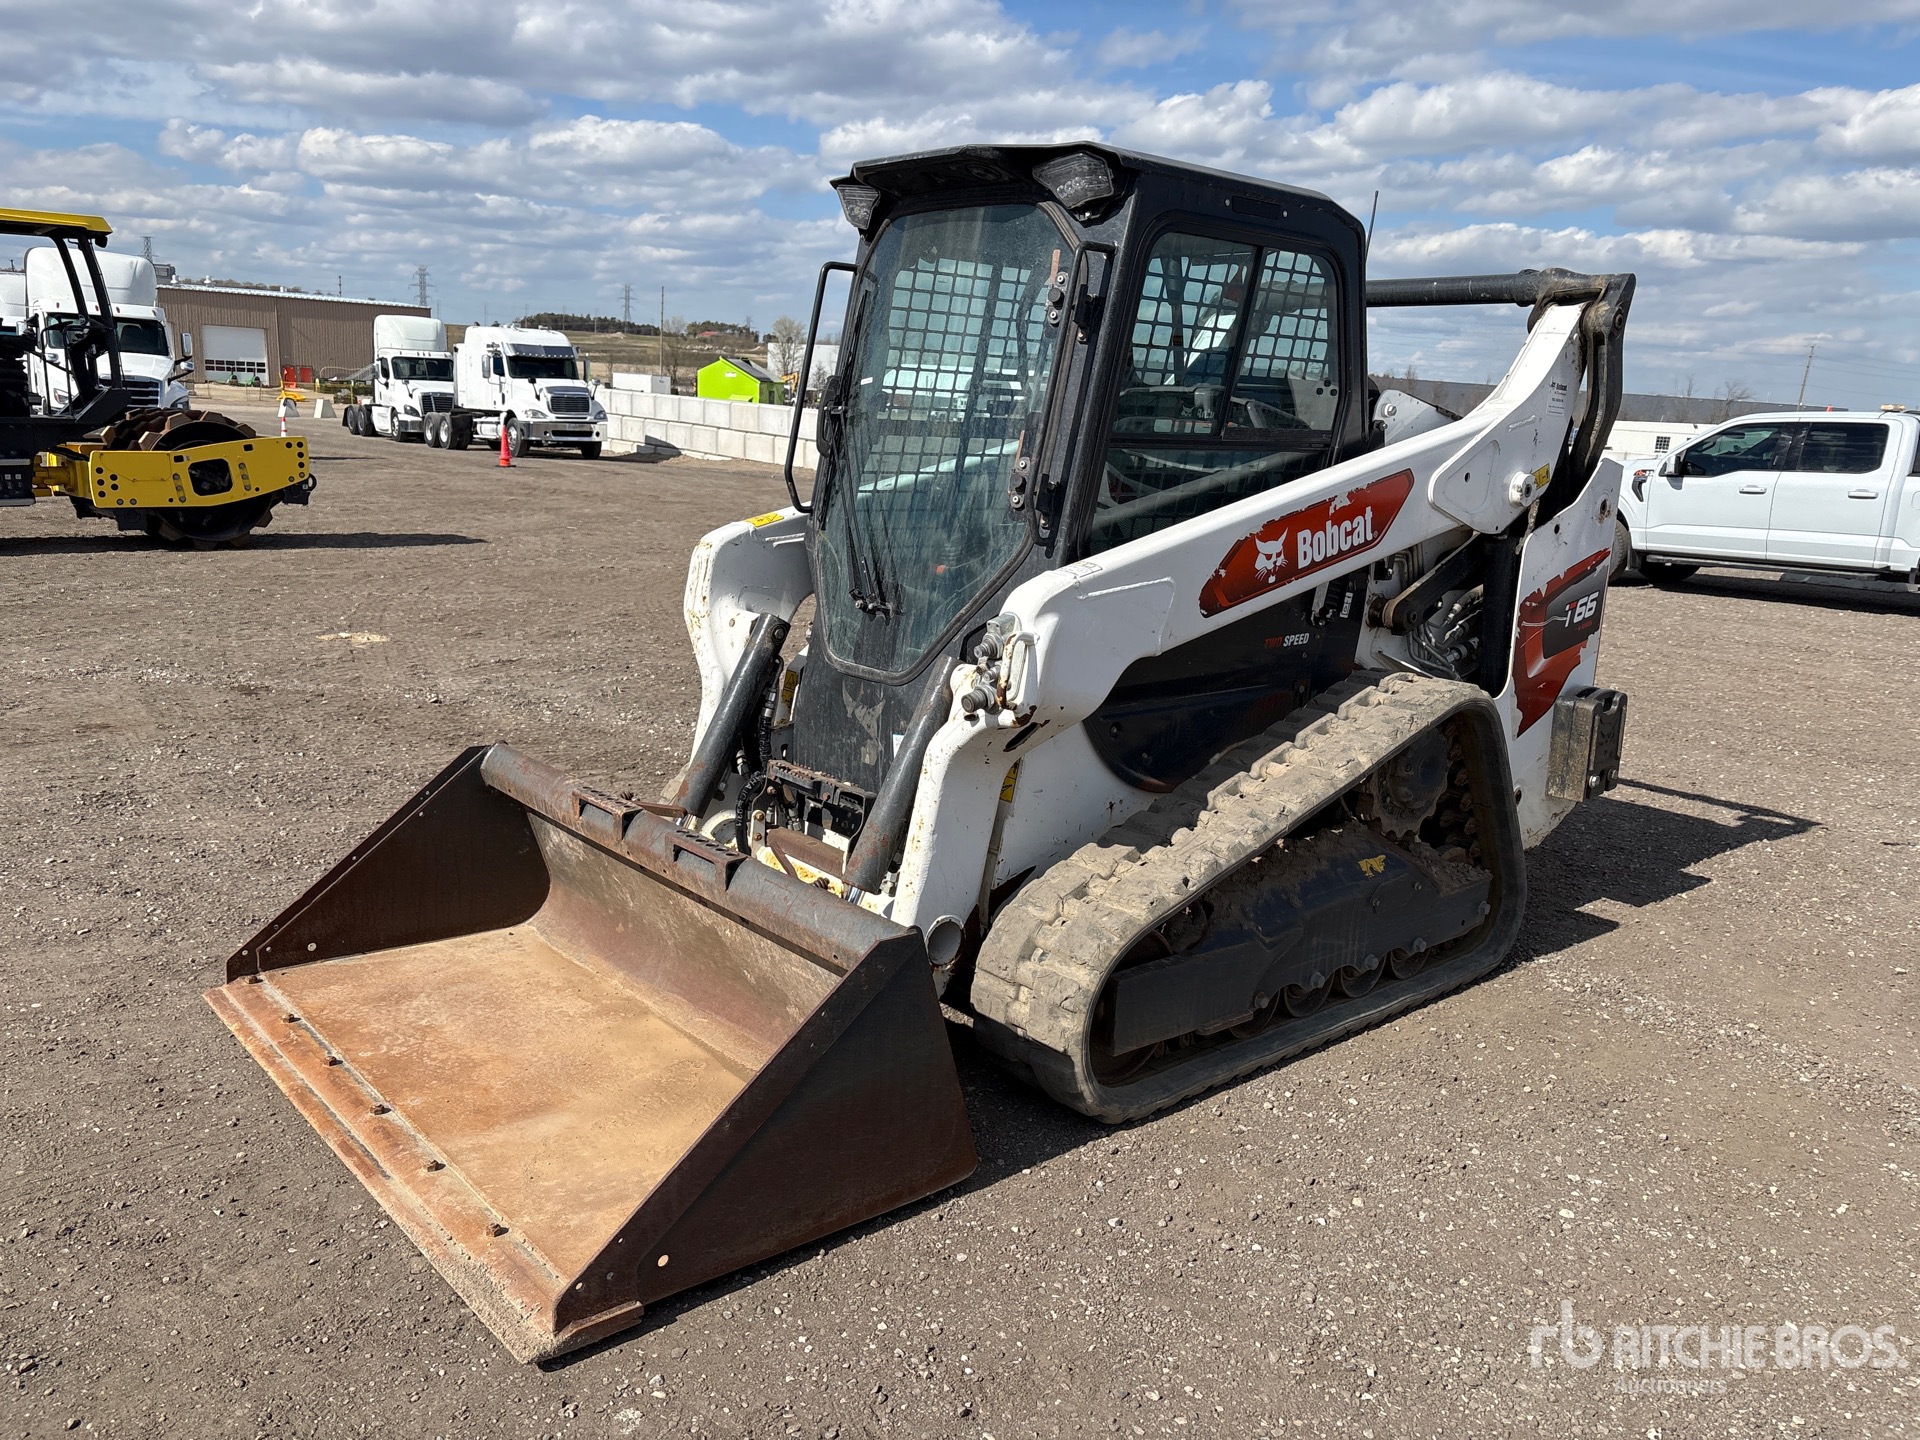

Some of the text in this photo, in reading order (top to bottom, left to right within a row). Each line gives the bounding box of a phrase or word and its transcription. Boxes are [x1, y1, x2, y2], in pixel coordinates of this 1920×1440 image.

[1297, 506, 1373, 569] Bobcat
[1263, 633, 1310, 649] TWO SPEED
